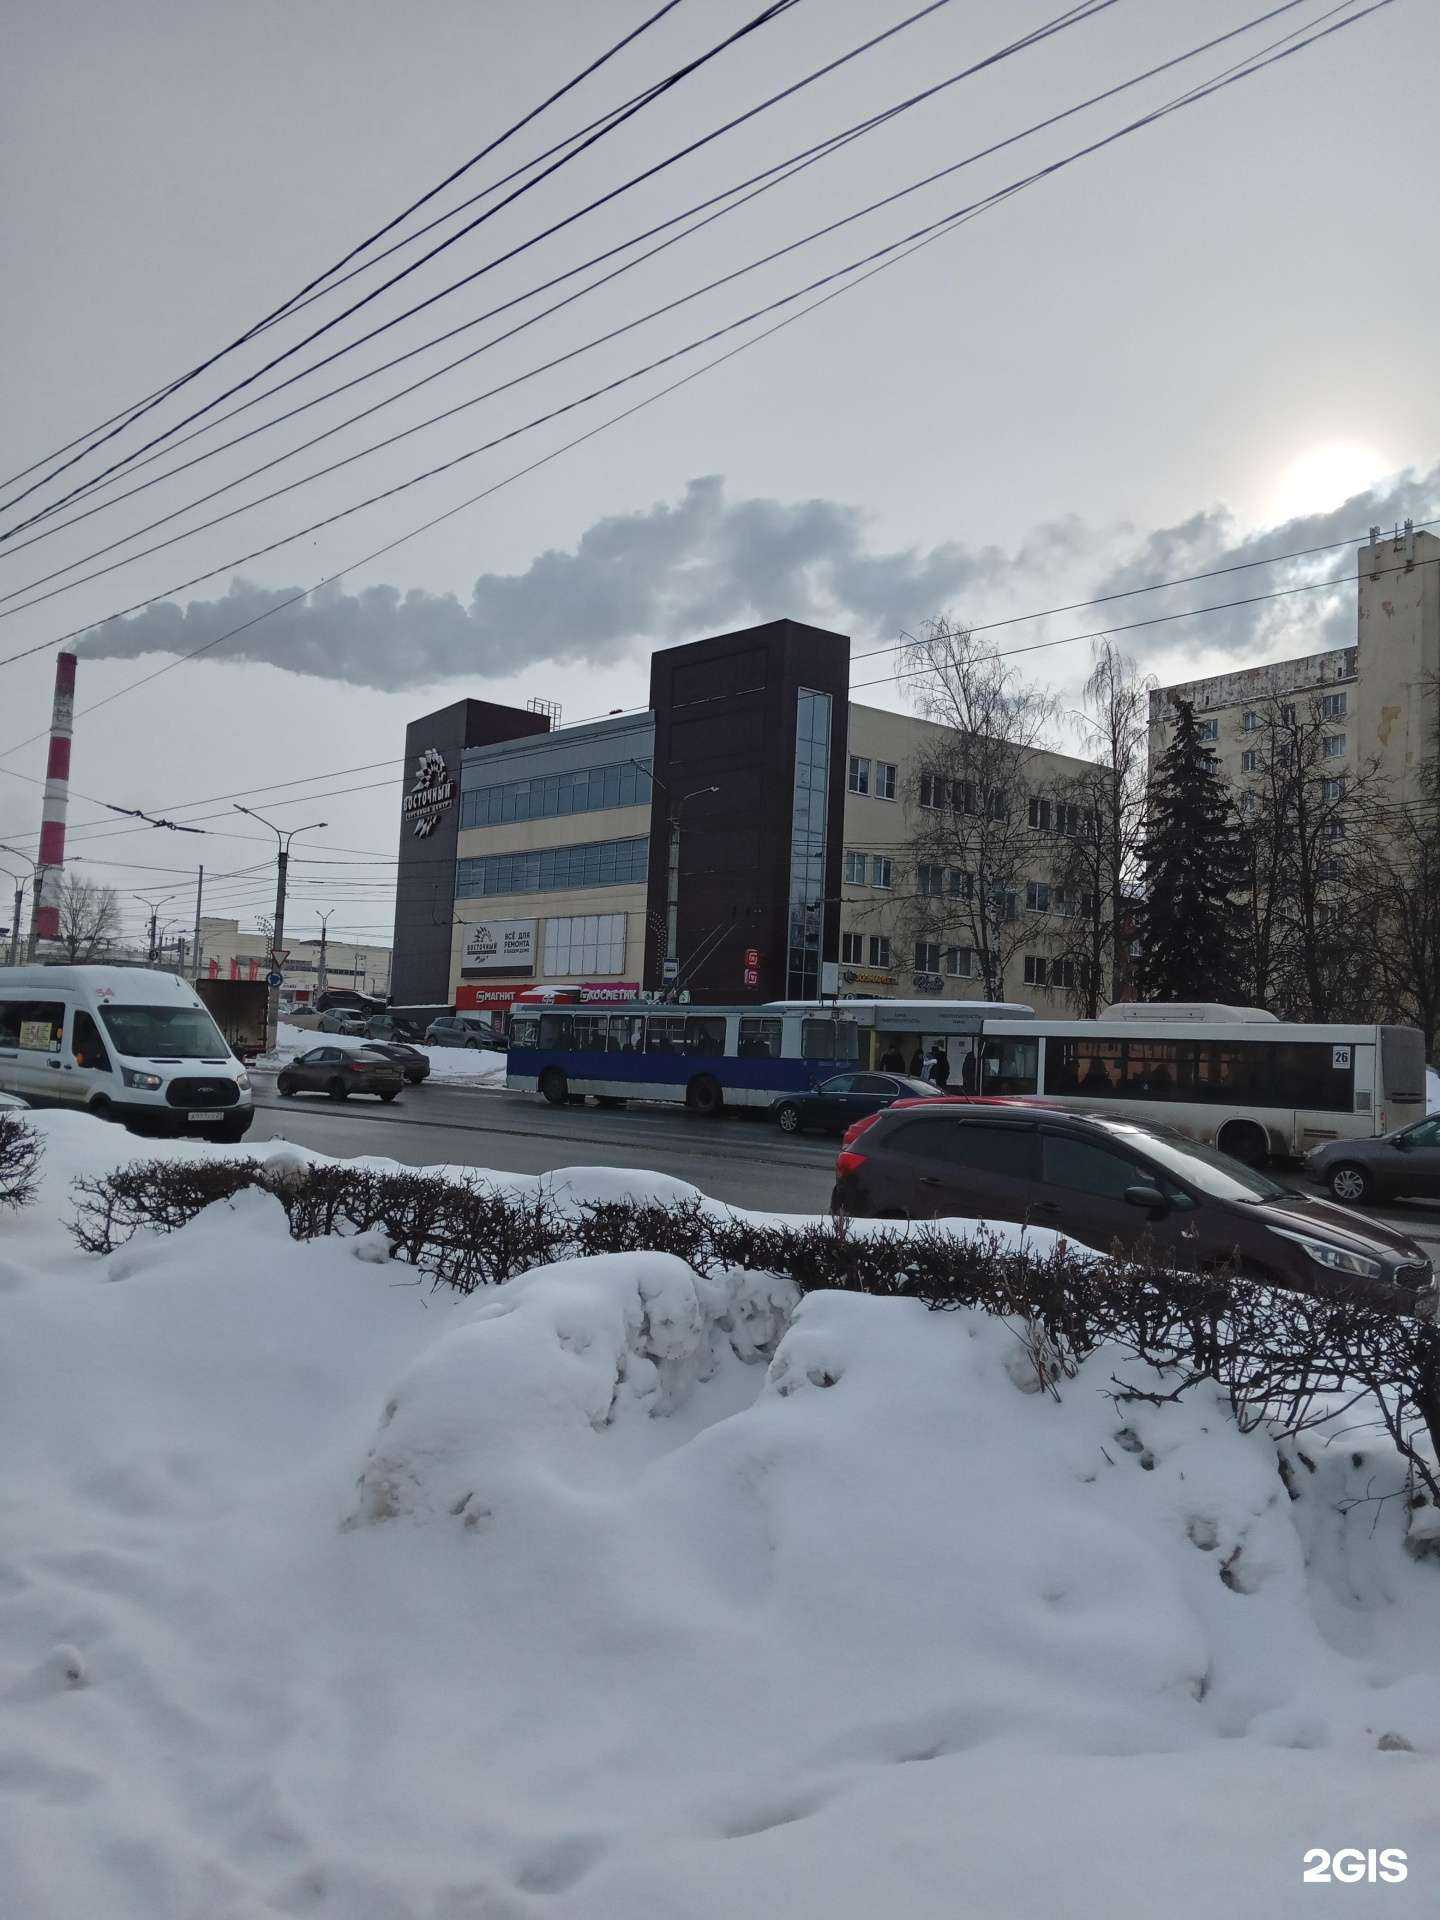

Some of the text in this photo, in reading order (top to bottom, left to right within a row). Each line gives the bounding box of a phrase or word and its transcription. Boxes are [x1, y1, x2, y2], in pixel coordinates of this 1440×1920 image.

[403, 780, 453, 812] ВОСТОЧНЫЙ
[484, 991, 516, 1001] МАГНИТ
[588, 990, 637, 1001] КОСМЕТИК
[1336, 1052, 1348, 1063] 26
